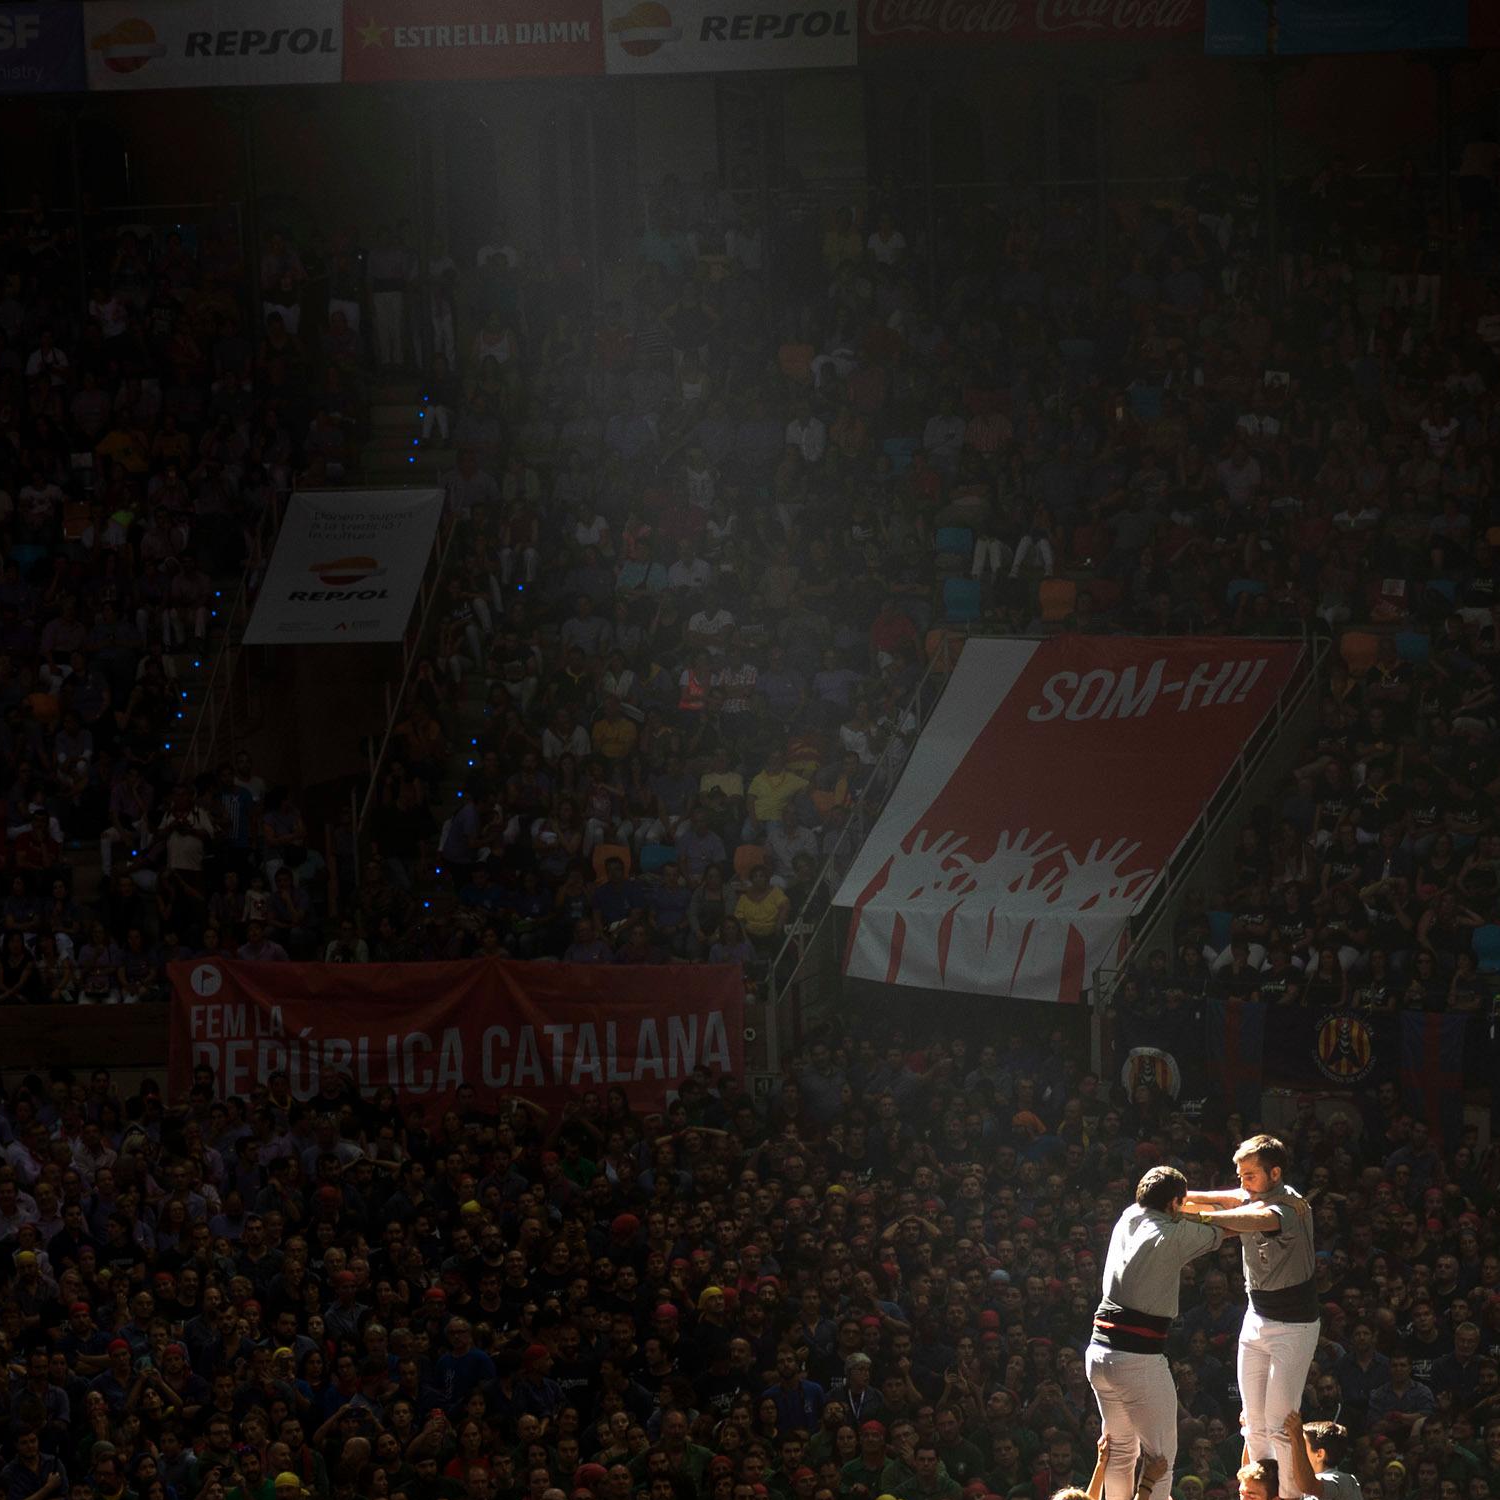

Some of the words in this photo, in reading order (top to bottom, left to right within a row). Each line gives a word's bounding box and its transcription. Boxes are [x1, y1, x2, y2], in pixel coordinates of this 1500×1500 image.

[394, 24, 510, 47] ESTRELLA
[515, 21, 591, 45] DAMM
[699, 10, 851, 41] REPSOL
[184, 28, 338, 57] REPSOL
[288, 589, 389, 602] REPSOL
[1027, 658, 1268, 722] SOM-HI!
[191, 1003, 246, 1039] FEM
[254, 1005, 285, 1037] LA
[481, 1010, 733, 1088] CATALANA
